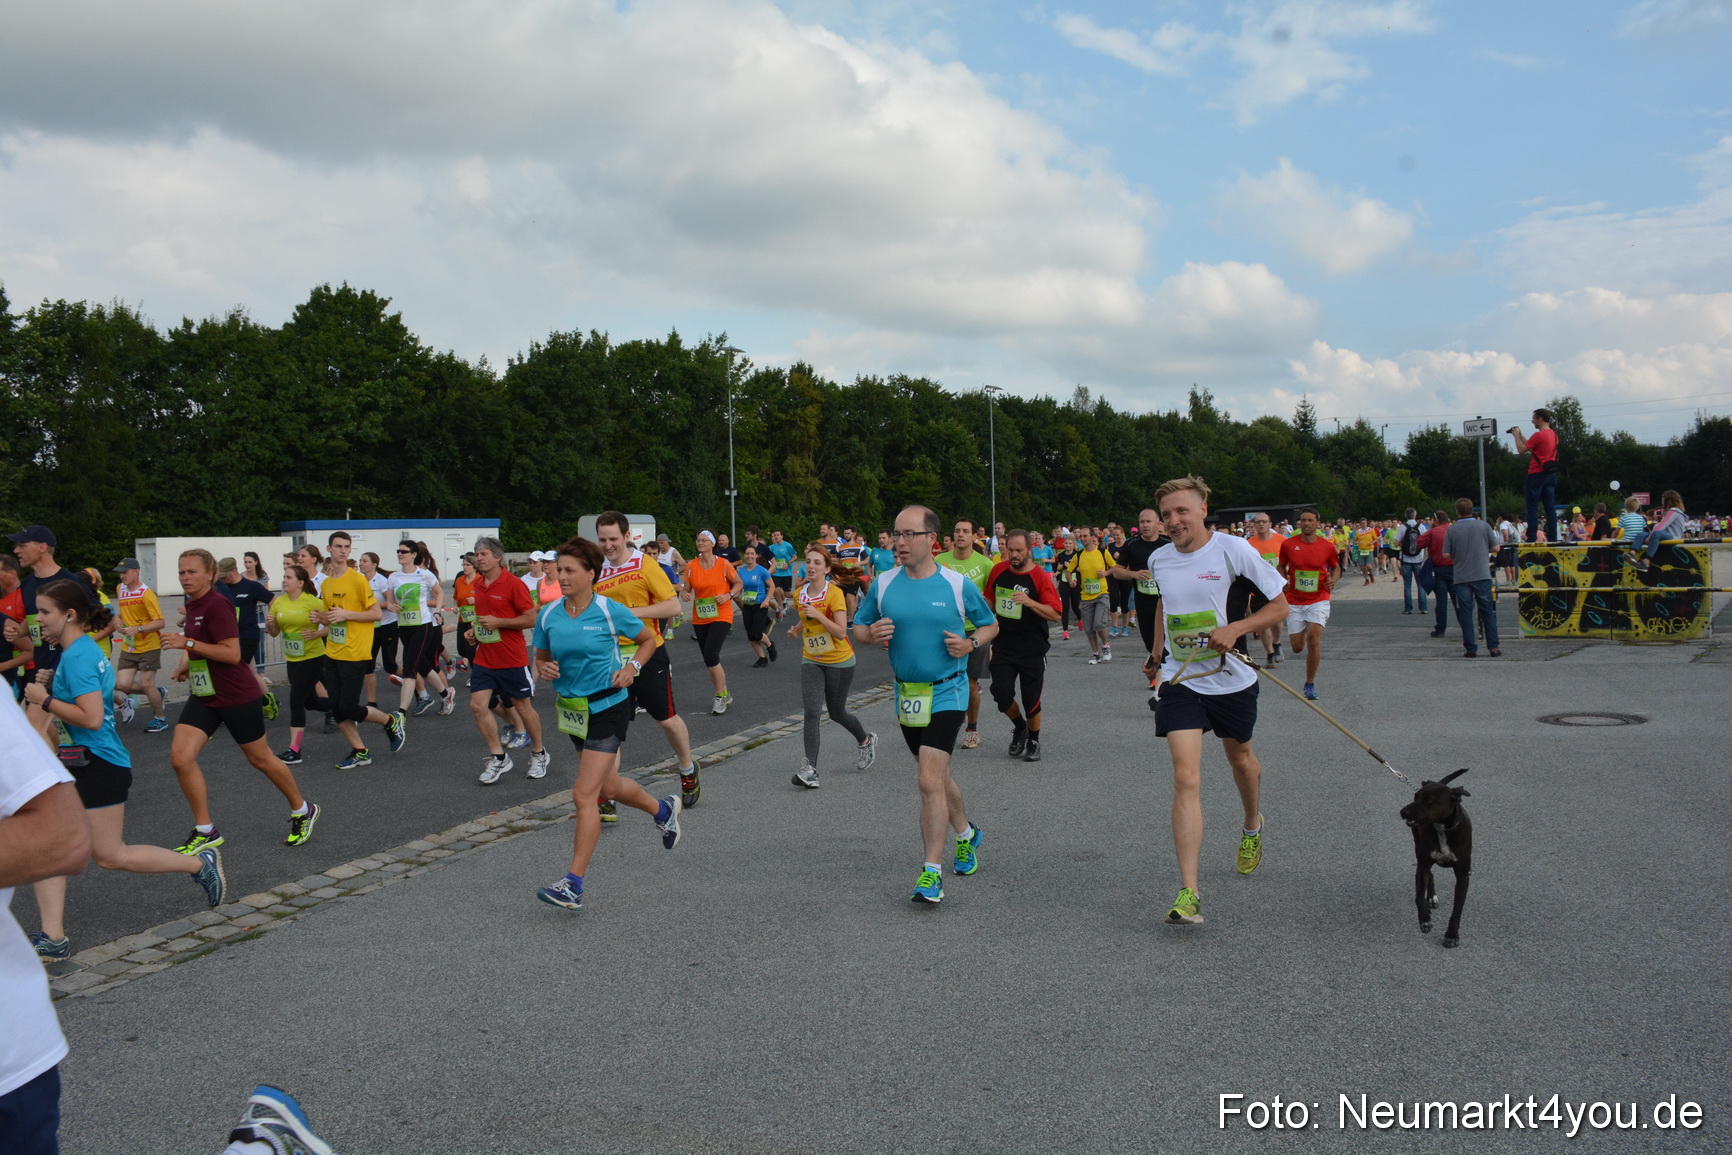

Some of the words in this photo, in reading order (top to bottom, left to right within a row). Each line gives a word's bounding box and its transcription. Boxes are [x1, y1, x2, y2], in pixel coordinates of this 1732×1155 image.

[1465, 424, 1478, 432] WC
[596, 582, 616, 594] MAX
[618, 573, 644, 586] BÖGL
[1140, 580, 1158, 588] 125
[1299, 578, 1314, 586] 964
[698, 604, 716, 614] 1035
[1002, 600, 1013, 610] 33
[402, 612, 416, 620] 102
[808, 636, 826, 648] 913
[564, 710, 584, 726] 418
